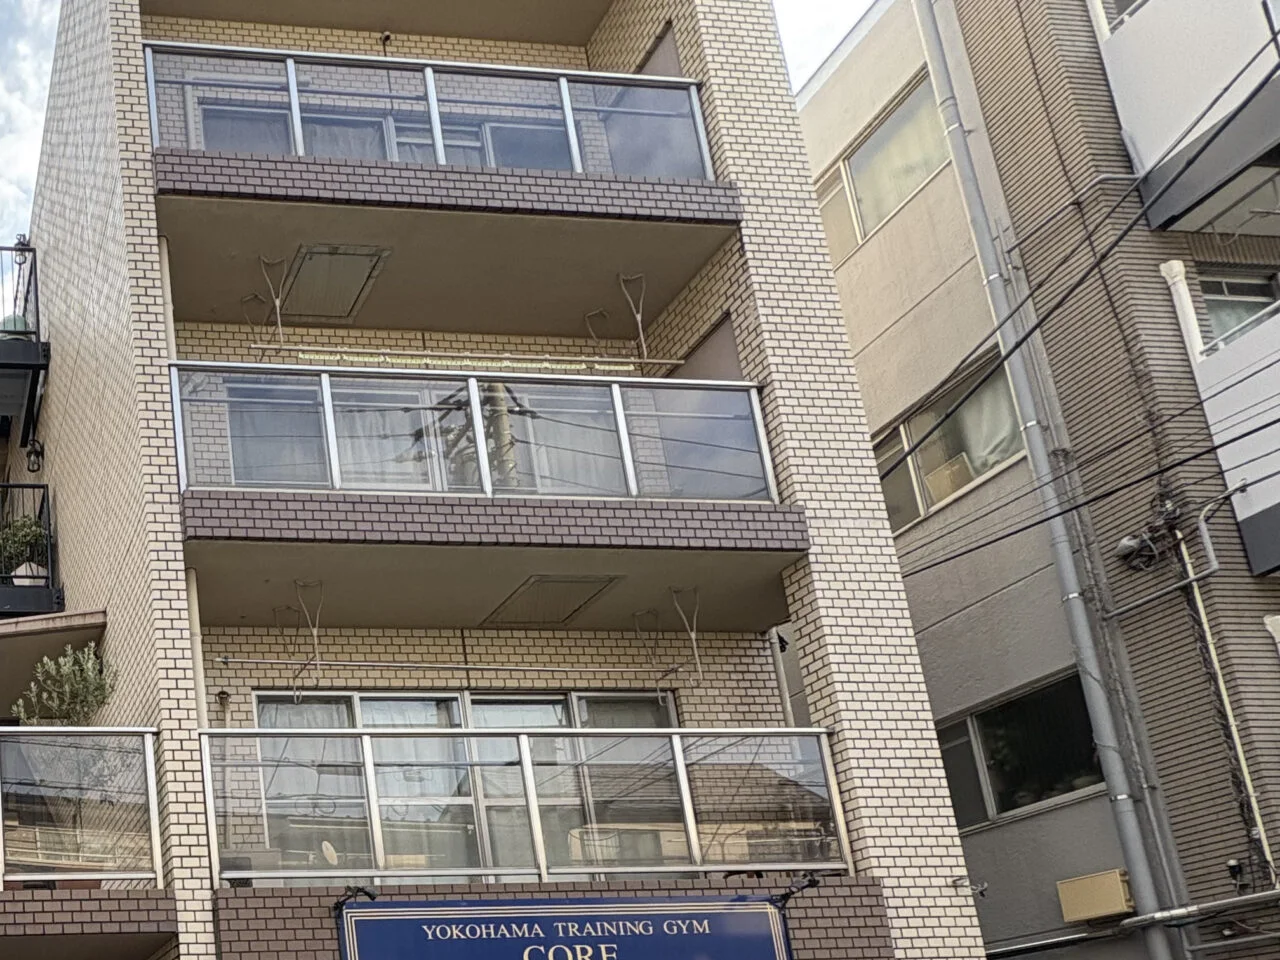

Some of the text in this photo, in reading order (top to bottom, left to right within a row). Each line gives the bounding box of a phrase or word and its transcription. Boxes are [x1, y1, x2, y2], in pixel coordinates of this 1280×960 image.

[421, 918, 712, 941] YOKOHAMA TRAINING GYM
